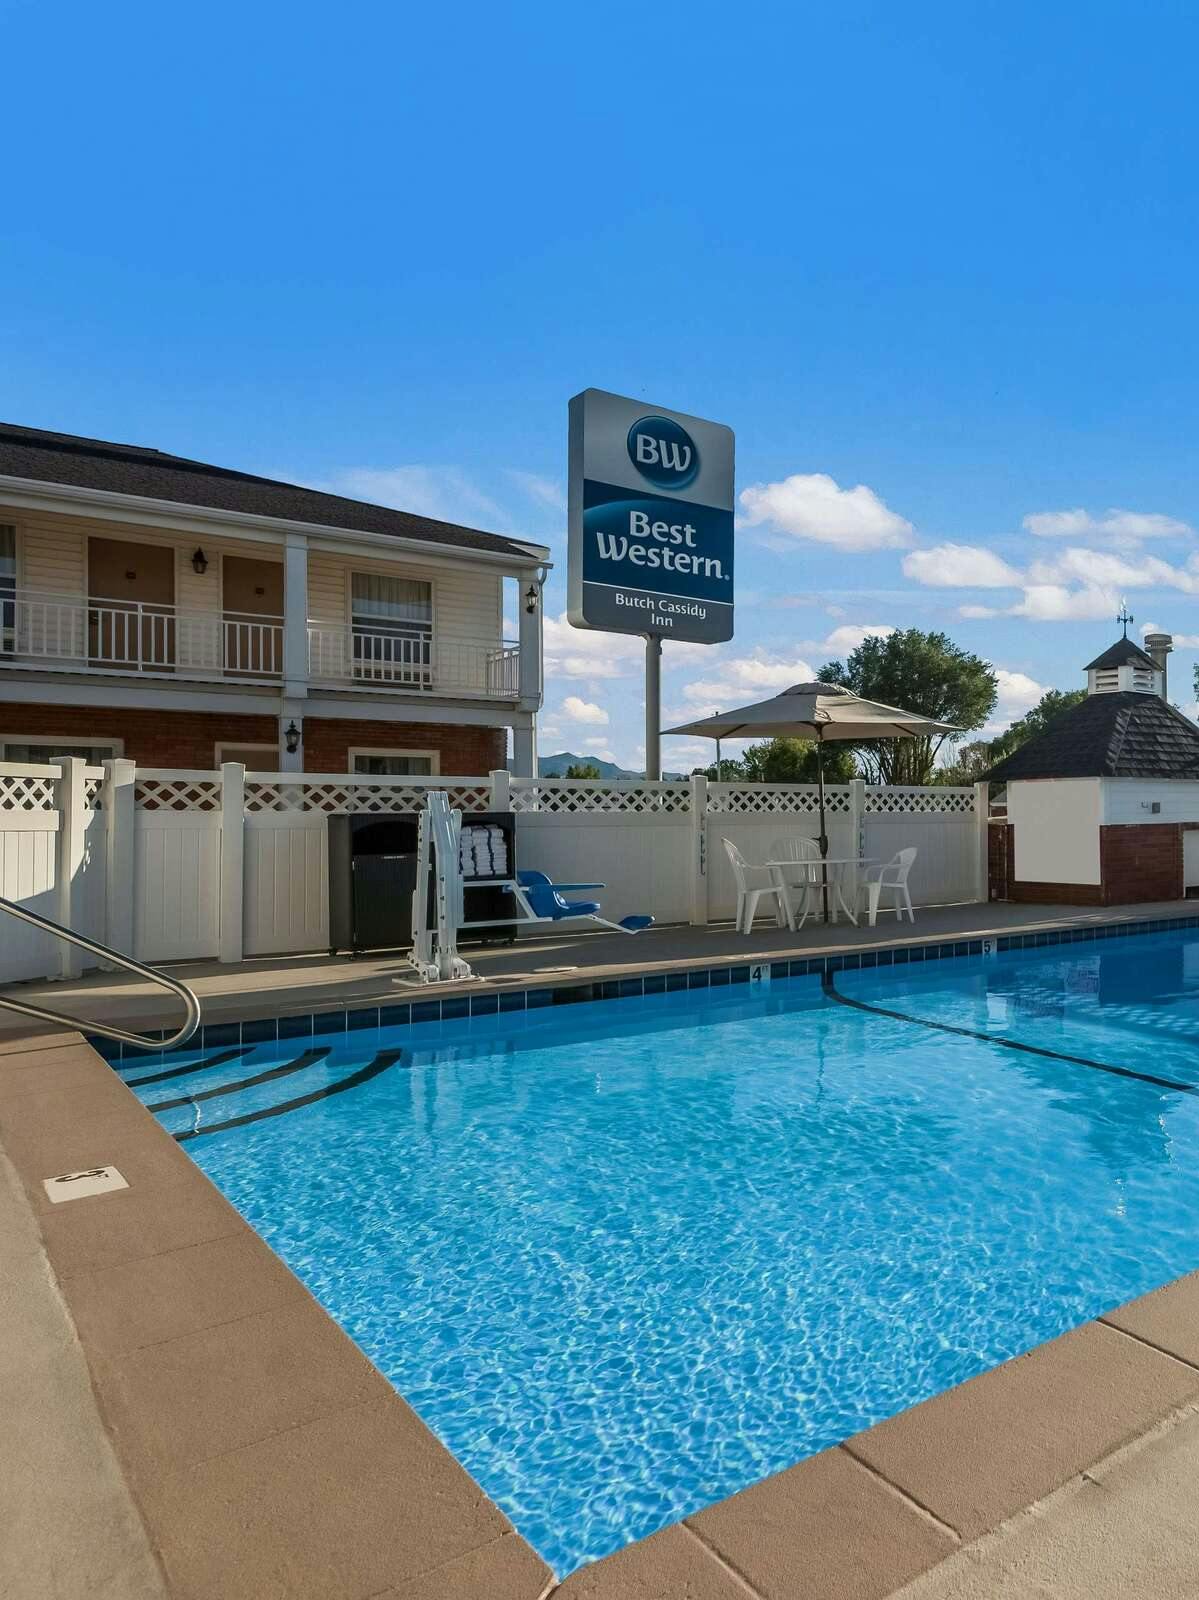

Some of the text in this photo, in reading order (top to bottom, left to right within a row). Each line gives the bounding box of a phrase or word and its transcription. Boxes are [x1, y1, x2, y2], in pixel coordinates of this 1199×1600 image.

[637, 434, 691, 471] BW
[629, 511, 696, 547] Best
[597, 532, 723, 579] Western
[615, 593, 707, 620] Butch Cassidy
[650, 613, 673, 627] Inn
[984, 940, 991, 952] 5
[752, 966, 762, 981] 4
